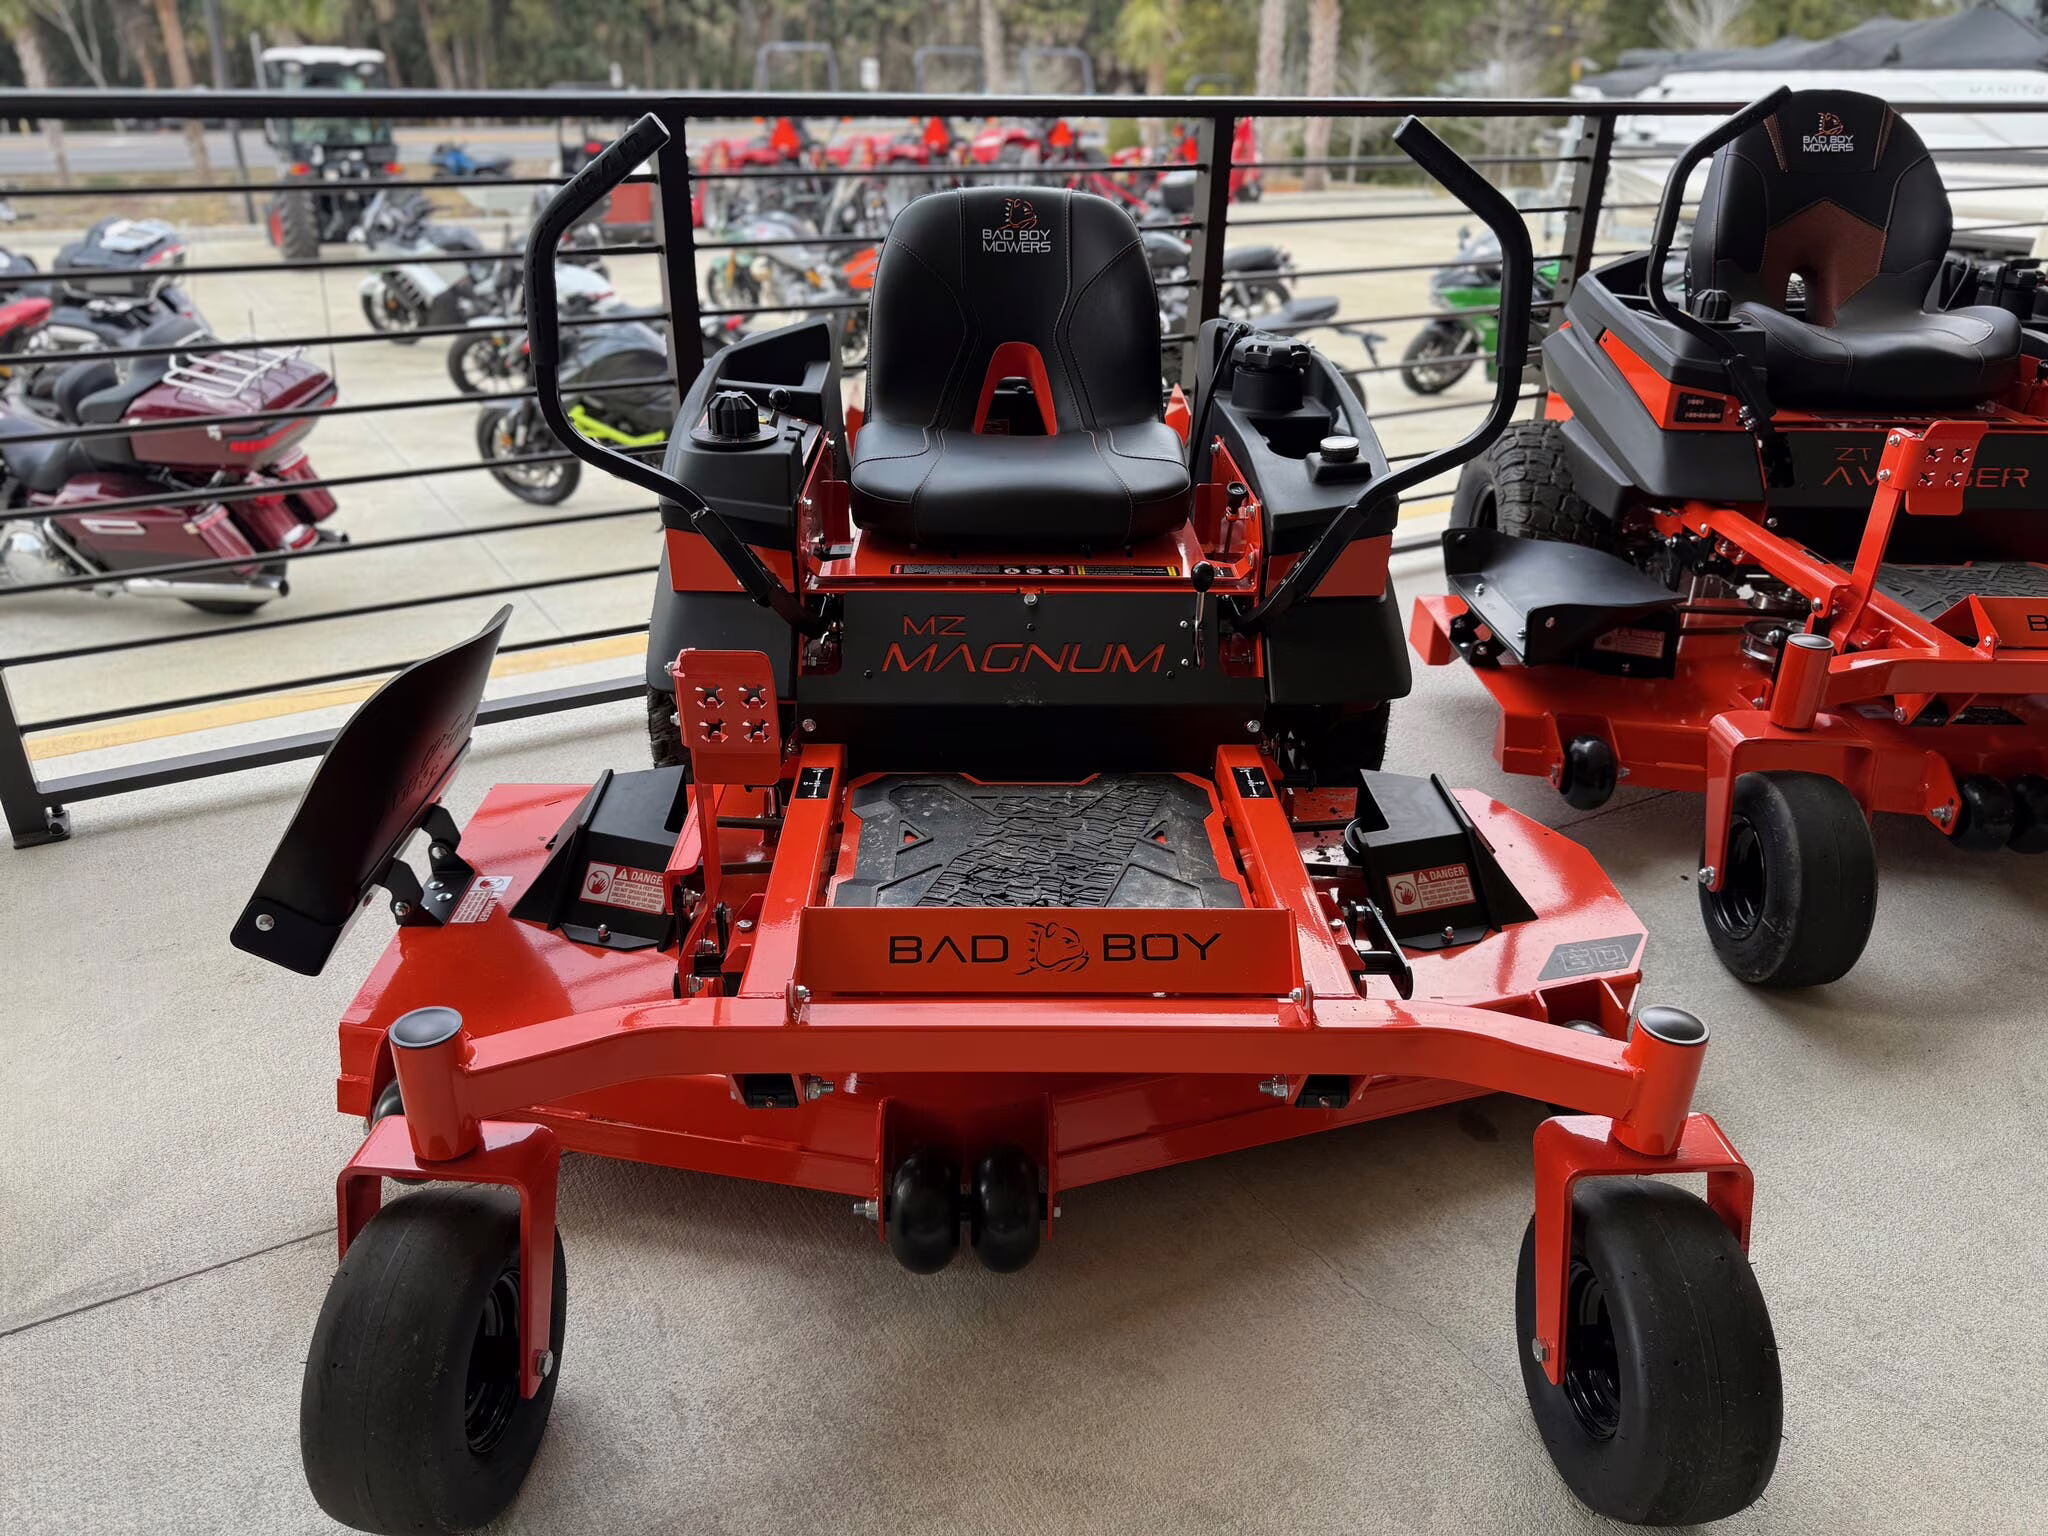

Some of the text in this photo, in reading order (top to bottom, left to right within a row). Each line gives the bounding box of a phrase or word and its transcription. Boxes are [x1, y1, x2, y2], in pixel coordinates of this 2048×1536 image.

[1803, 135, 1854, 144] BAD BOY
[1803, 144, 1854, 152] MOWERS
[982, 229, 1051, 240] BAD BOY
[982, 240, 1051, 253] MOWERS
[1834, 447, 1872, 461] ZT
[903, 615, 966, 636] MZ
[881, 642, 1166, 673] MAGNUM
[630, 871, 664, 886] DANGE
[1430, 866, 1466, 881] DANGER
[889, 933, 1222, 964] BAD BOY
